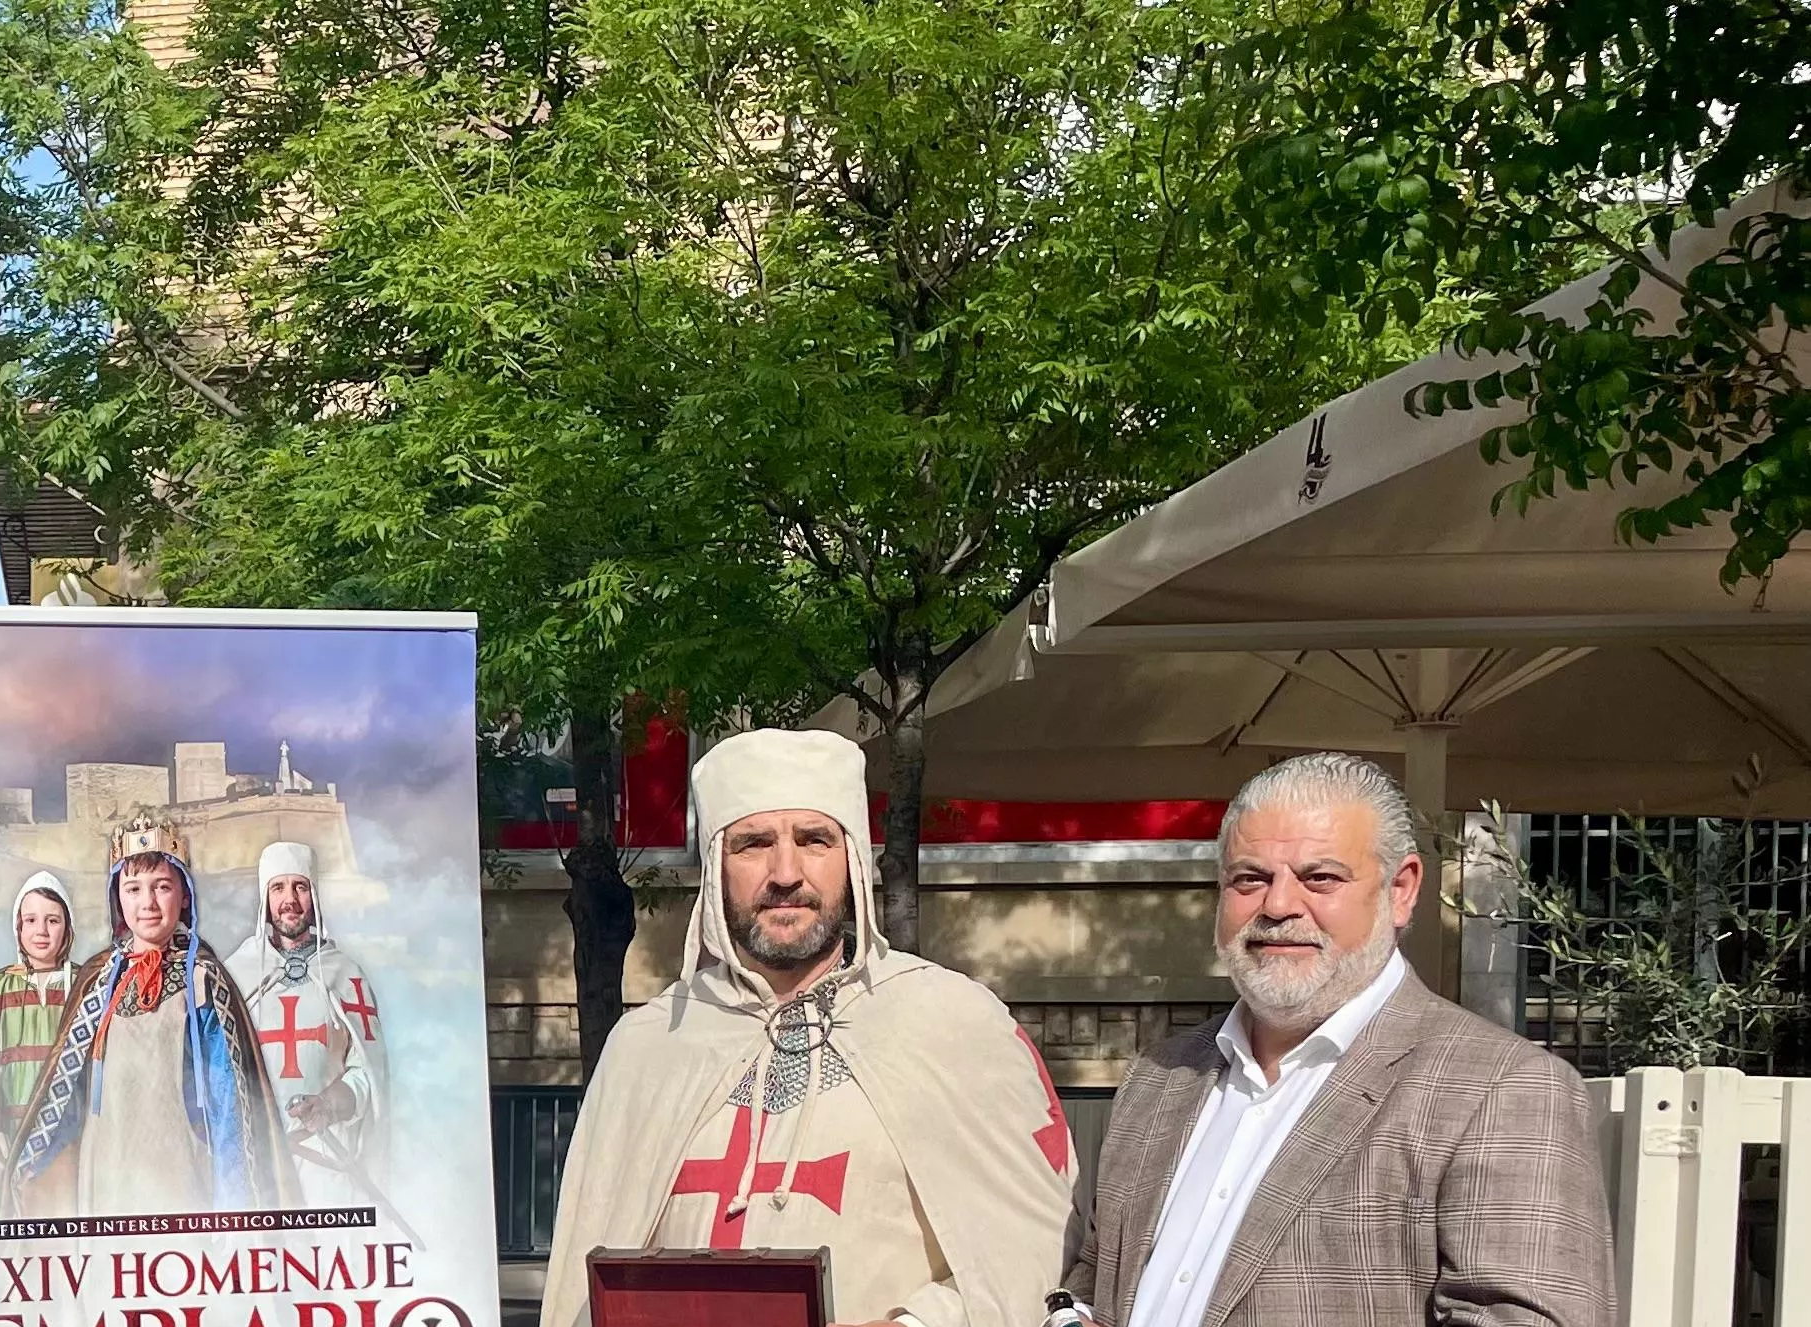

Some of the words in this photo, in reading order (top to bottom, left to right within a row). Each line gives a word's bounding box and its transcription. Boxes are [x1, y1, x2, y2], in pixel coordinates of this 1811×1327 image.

[0, 1223, 59, 1237] FIESTA
[66, 1221, 89, 1235] DE
[95, 1217, 169, 1233] INTERÉS
[175, 1214, 275, 1230] TURÍSTICO
[281, 1211, 371, 1227] NACIONAL
[112, 1242, 414, 1299] HOMENAJE
